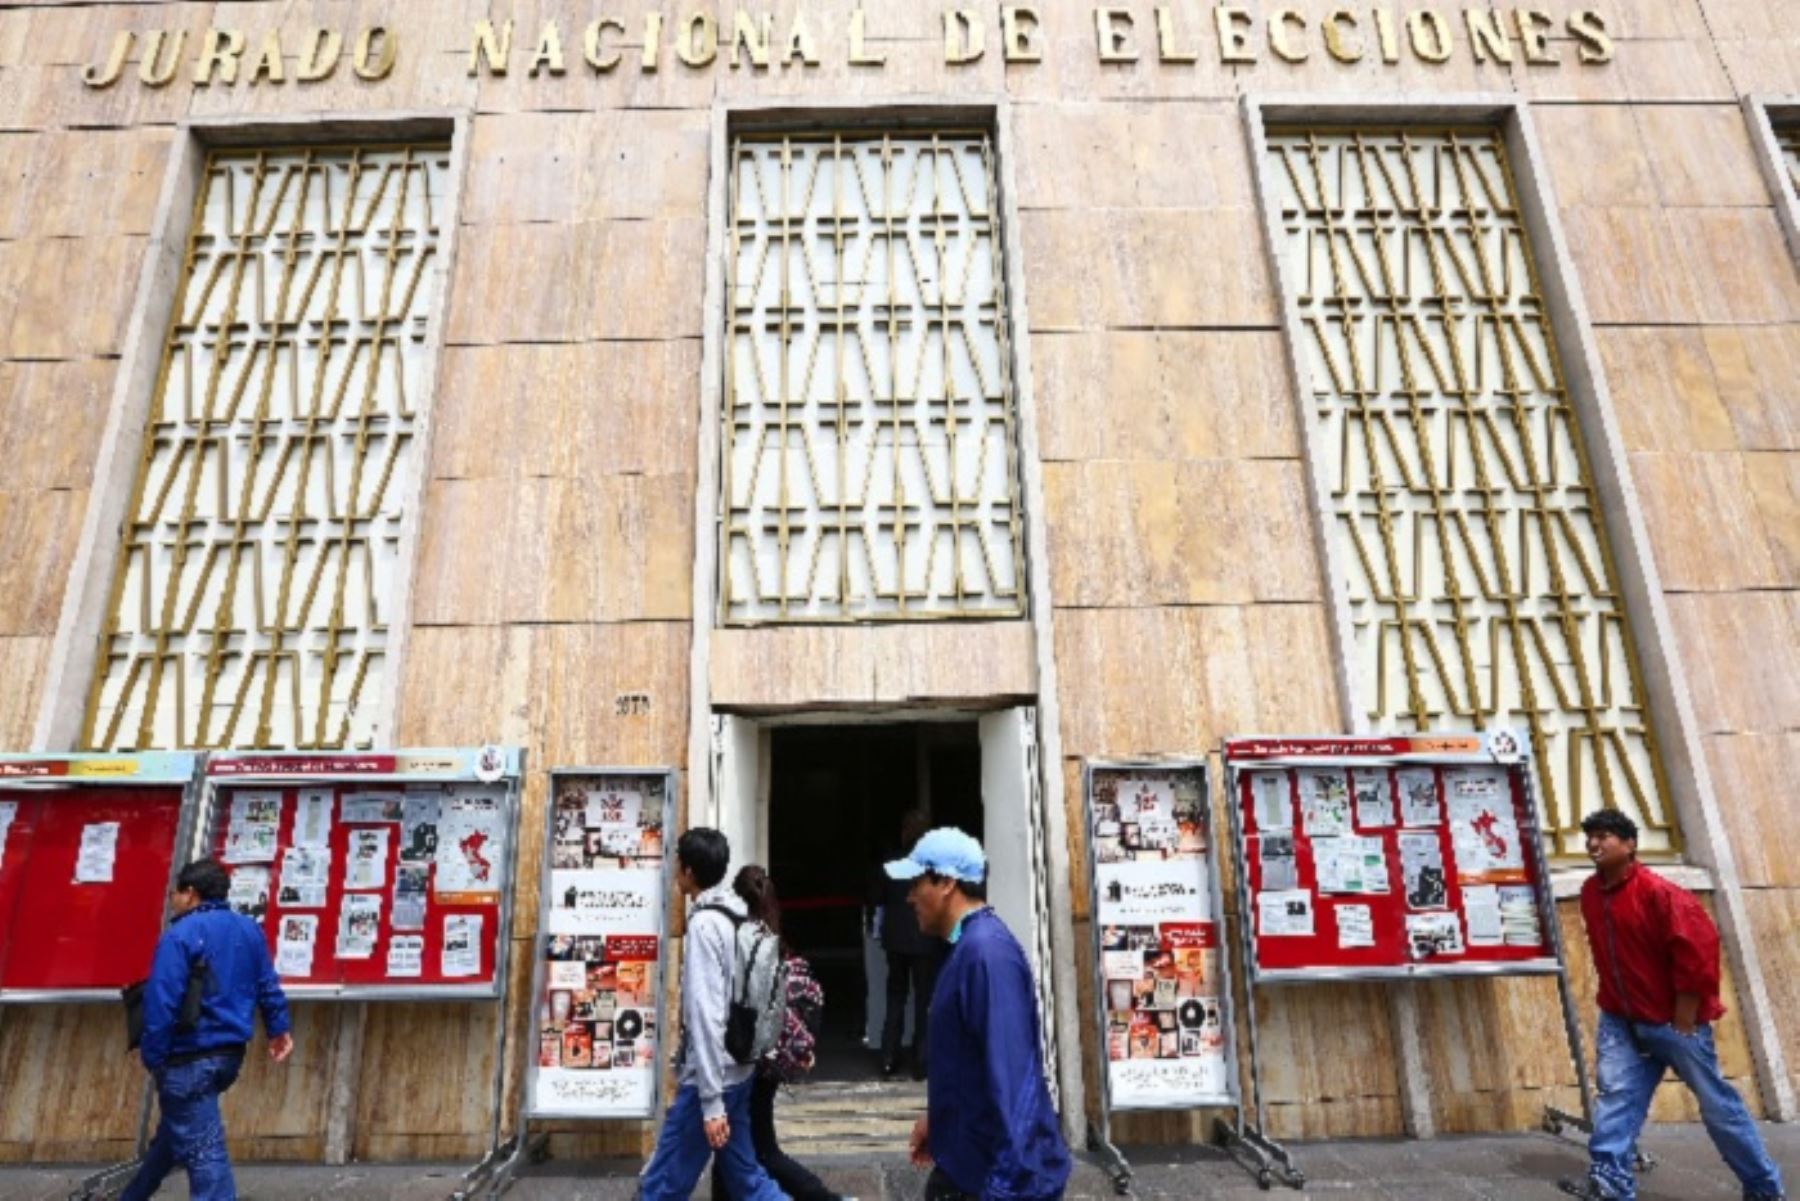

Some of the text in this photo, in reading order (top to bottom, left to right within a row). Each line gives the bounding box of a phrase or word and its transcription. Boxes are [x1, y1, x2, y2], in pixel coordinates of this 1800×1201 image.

[82, 7, 1615, 88] JURADO NACIONAL DE ELECCIONES
